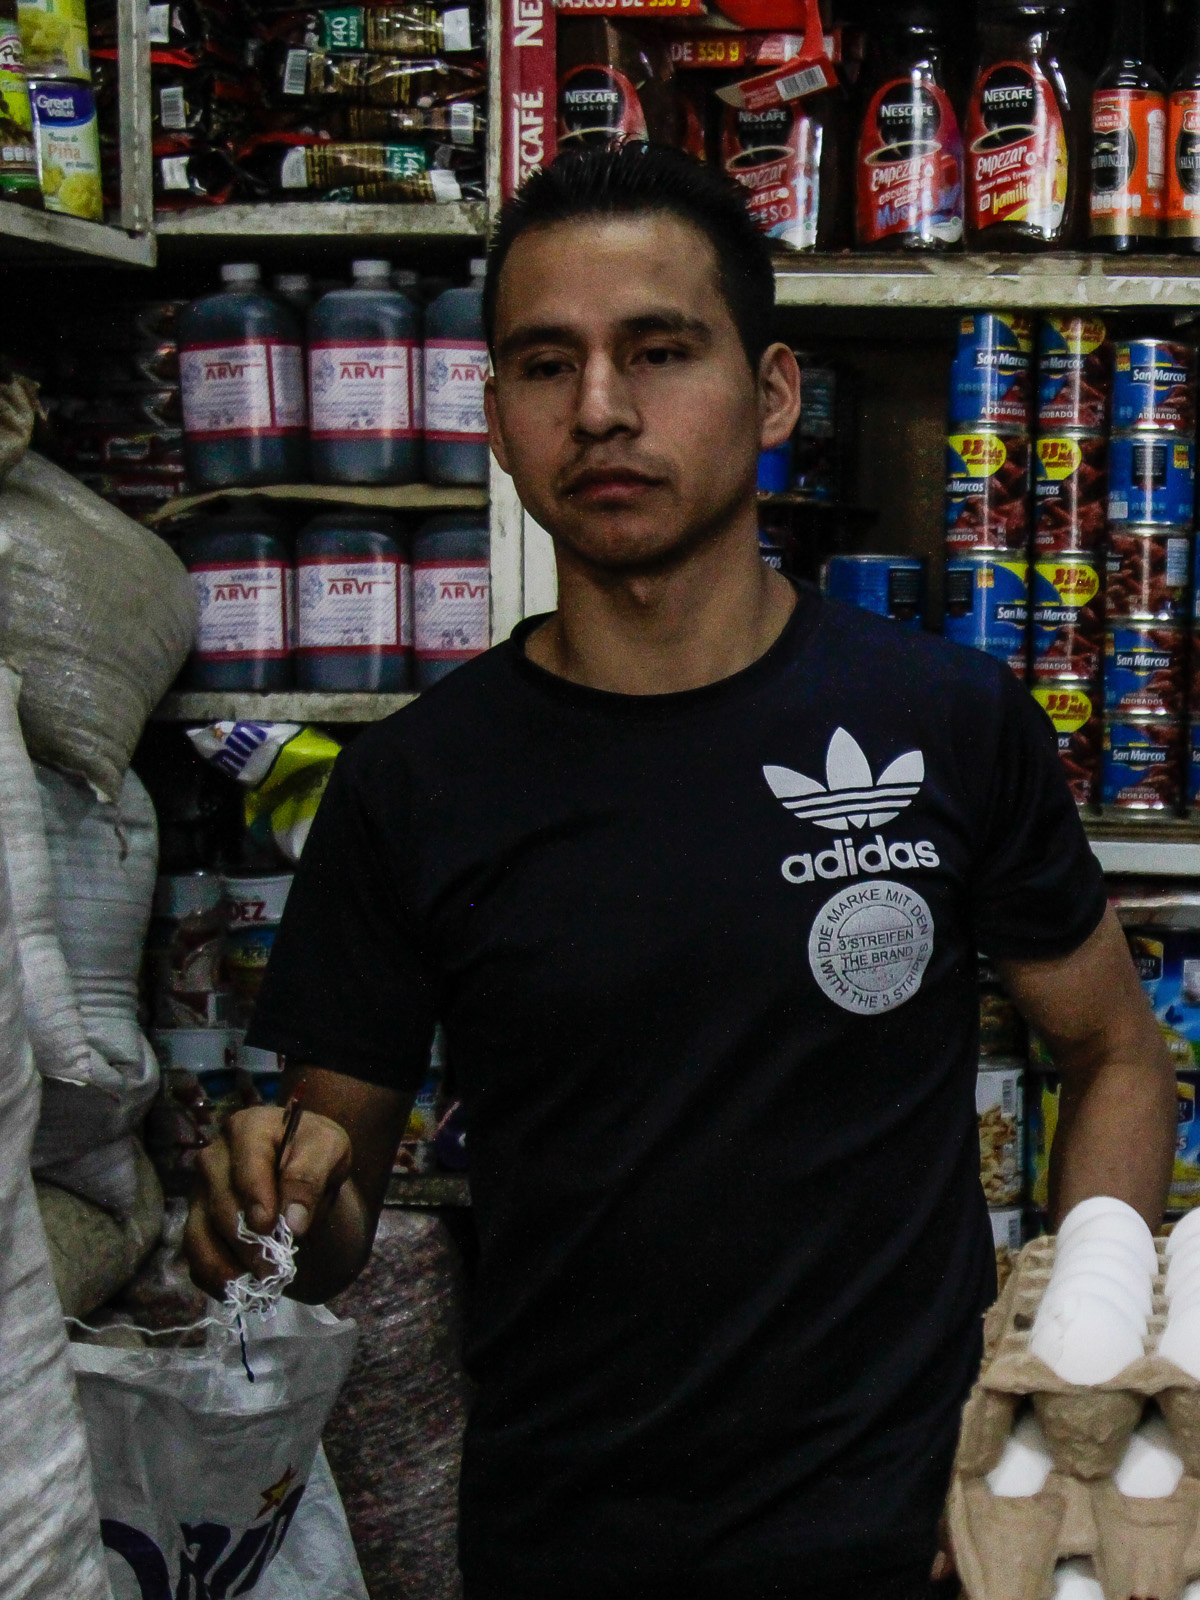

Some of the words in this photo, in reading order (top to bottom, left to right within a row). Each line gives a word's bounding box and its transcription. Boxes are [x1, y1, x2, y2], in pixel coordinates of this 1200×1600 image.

[512, 90, 544, 184] SCAFÉ
[976, 352, 998, 366] San
[205, 363, 245, 381] ARVI
[340, 362, 386, 380] ARVI
[1133, 368, 1150, 381] San
[1151, 369, 1187, 383] Marcos
[952, 480, 985, 493] Marcos
[214, 586, 259, 602] ARVI
[327, 581, 376, 596] ARVI
[997, 606, 1014, 620] San
[1043, 609, 1078, 622] Marcos
[1116, 655, 1133, 667] San
[1134, 654, 1170, 668] Marcos
[1112, 749, 1129, 761] San
[1130, 749, 1166, 762] Marcos
[781, 834, 940, 884] adidas
[817, 924, 834, 954] DIE
[827, 888, 881, 924] MARKE
[885, 888, 912, 909] MIT
[911, 903, 929, 936] DEN
[842, 953, 869, 971] THE
[871, 946, 914, 964] BRAND
[820, 959, 850, 997] WITH
[850, 990, 878, 1009] THE
[883, 993, 891, 1007] 3
[893, 942, 930, 1001] STRIPES
